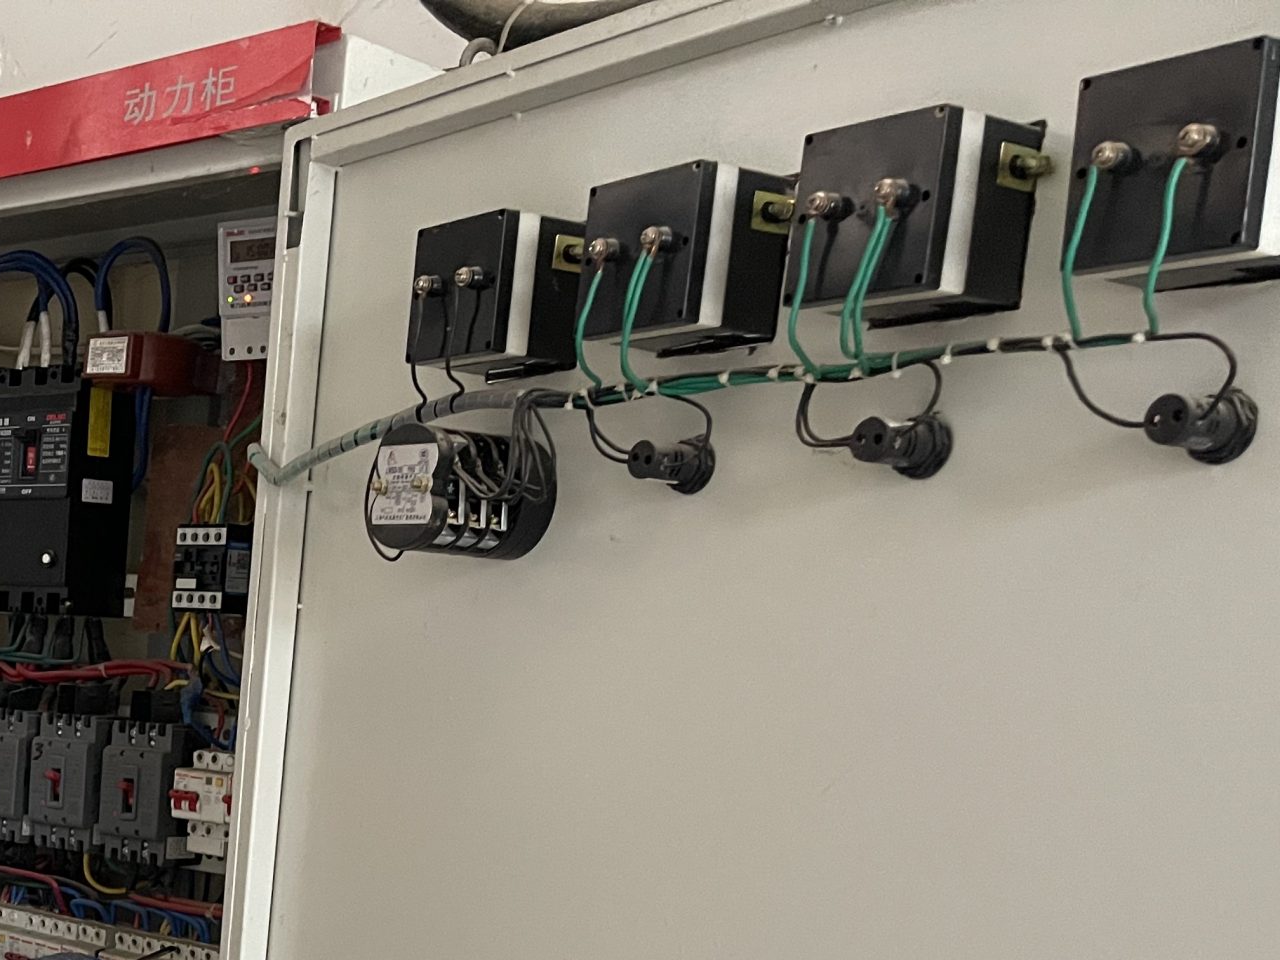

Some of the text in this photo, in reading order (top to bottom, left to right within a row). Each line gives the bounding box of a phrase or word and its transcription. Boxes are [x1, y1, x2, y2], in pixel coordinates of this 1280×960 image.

[123, 66, 237, 126] 动力柜
[31, 742, 44, 761] 3
